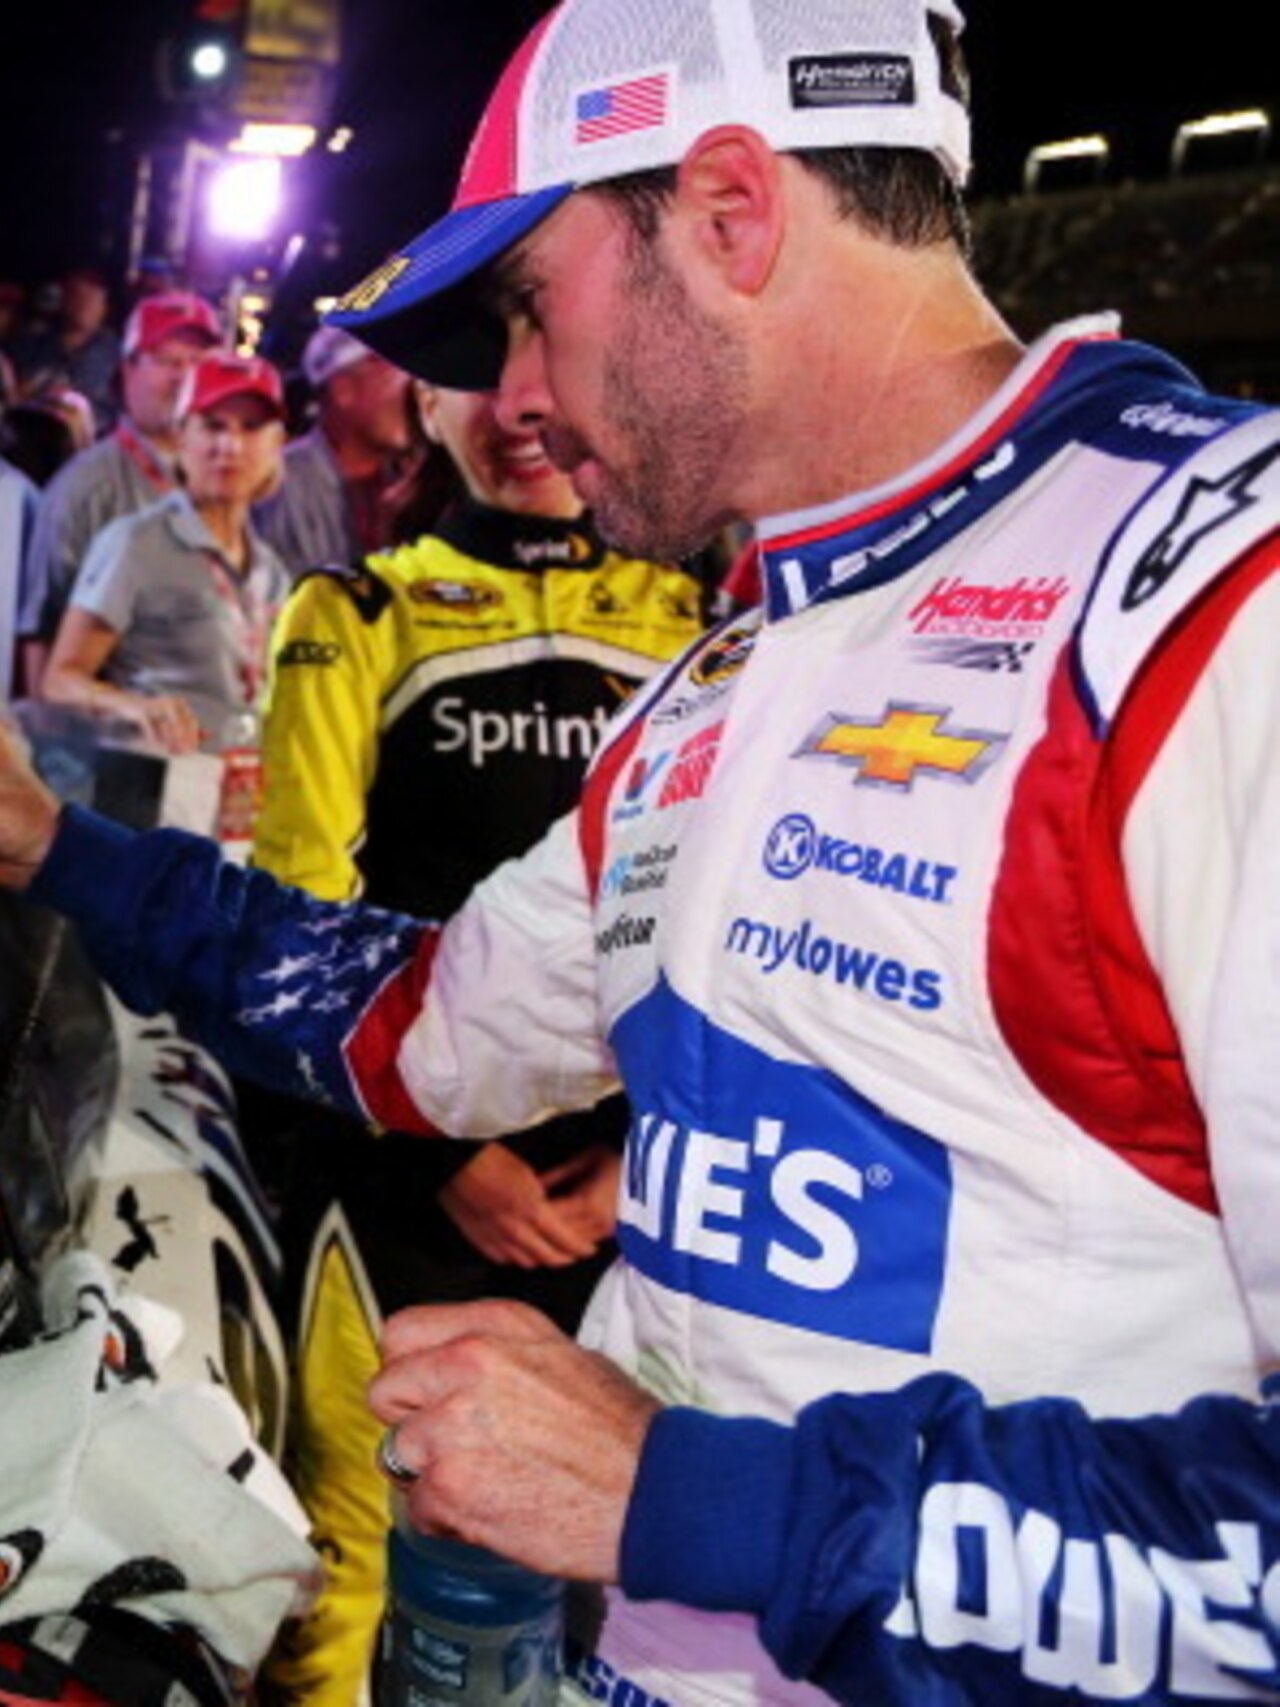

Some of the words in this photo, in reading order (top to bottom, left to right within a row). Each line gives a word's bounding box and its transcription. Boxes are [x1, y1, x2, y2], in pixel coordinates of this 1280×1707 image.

[814, 832, 957, 902] KOBALT
[725, 916, 943, 1011] mylowes
[883, 1481, 1280, 1703] OWE'
